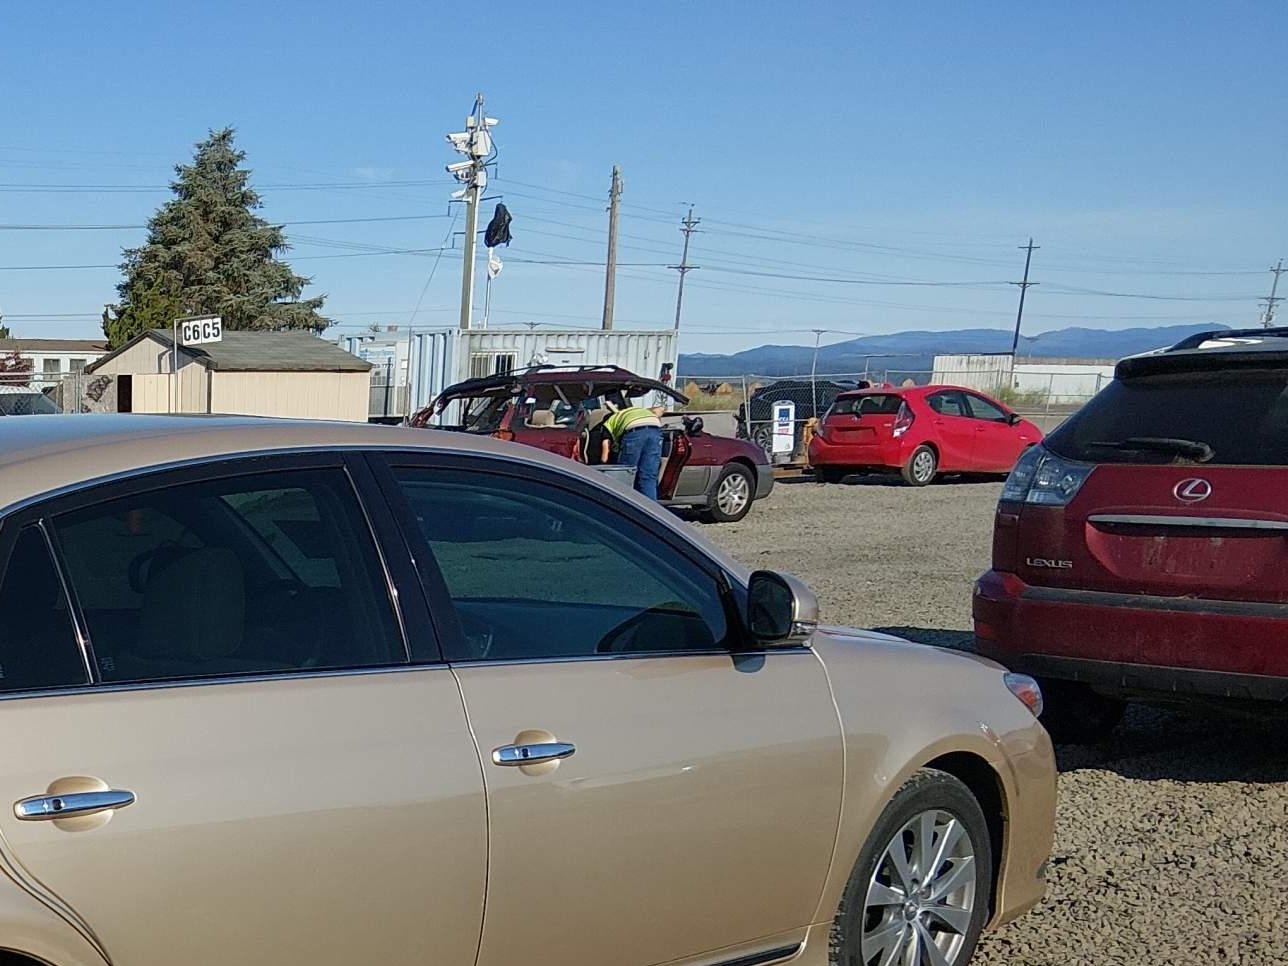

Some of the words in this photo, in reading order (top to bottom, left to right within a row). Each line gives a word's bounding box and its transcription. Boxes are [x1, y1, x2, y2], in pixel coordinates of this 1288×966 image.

[183, 324, 200, 341] C6
[203, 322, 220, 339] C5
[1026, 557, 1073, 569] LEXUS
